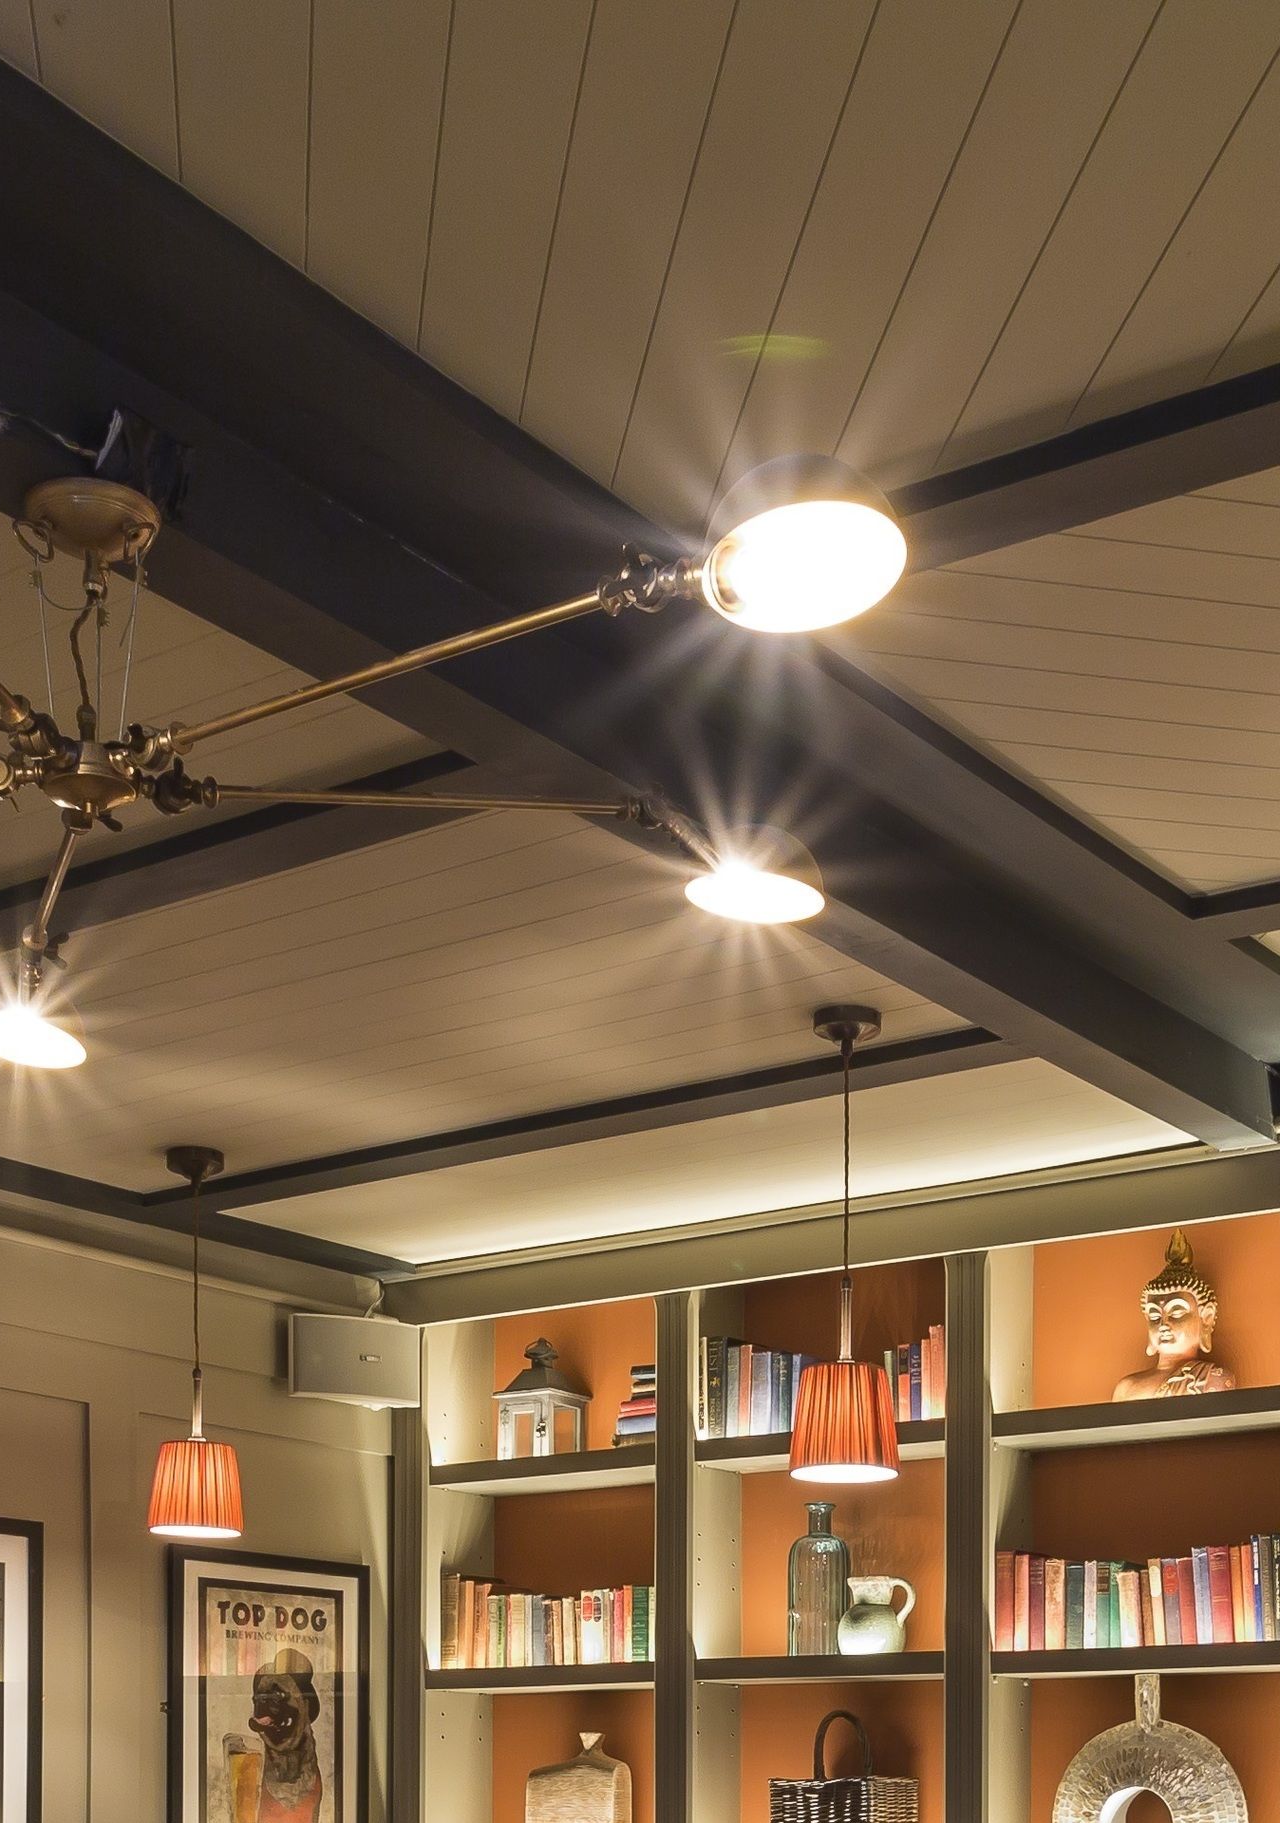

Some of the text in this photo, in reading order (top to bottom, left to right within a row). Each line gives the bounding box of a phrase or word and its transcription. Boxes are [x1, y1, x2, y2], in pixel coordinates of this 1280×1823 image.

[217, 1600, 327, 1632] TOP DOG
[225, 1630, 319, 1644] BREWING COMPANY
